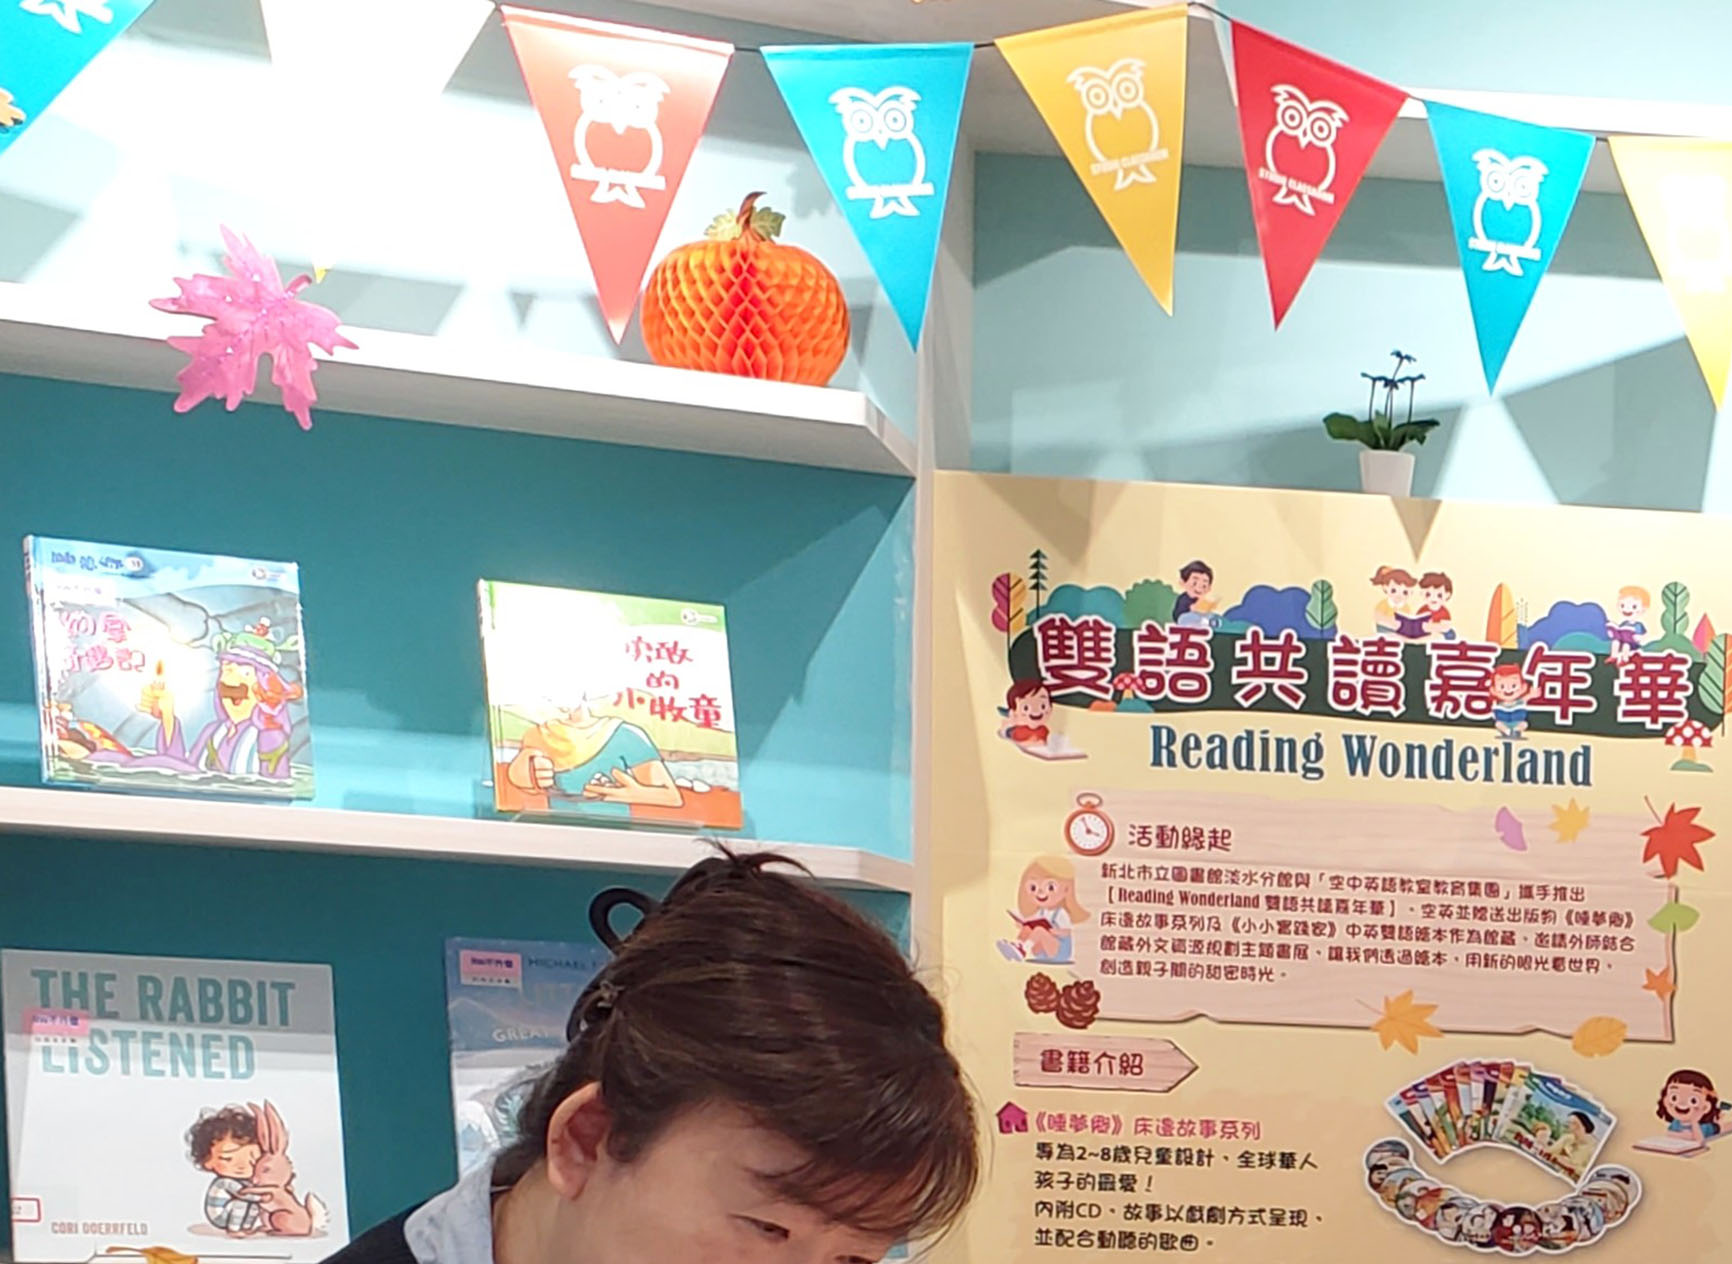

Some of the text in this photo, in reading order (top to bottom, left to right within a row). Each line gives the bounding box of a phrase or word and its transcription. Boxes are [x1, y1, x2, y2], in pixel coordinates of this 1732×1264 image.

[645, 669, 680, 690] 的
[1035, 616, 1692, 728] 雙語共讀嘉年華
[1150, 726, 1592, 788] Reading Wonderland
[1128, 823, 1232, 852] 活動緣起
[1178, 890, 1261, 911] Wonderland
[30, 968, 296, 1028] THE RABBIT
[41, 1027, 256, 1081] LISTENED
[1039, 1048, 1144, 1077] 書籍介紹
